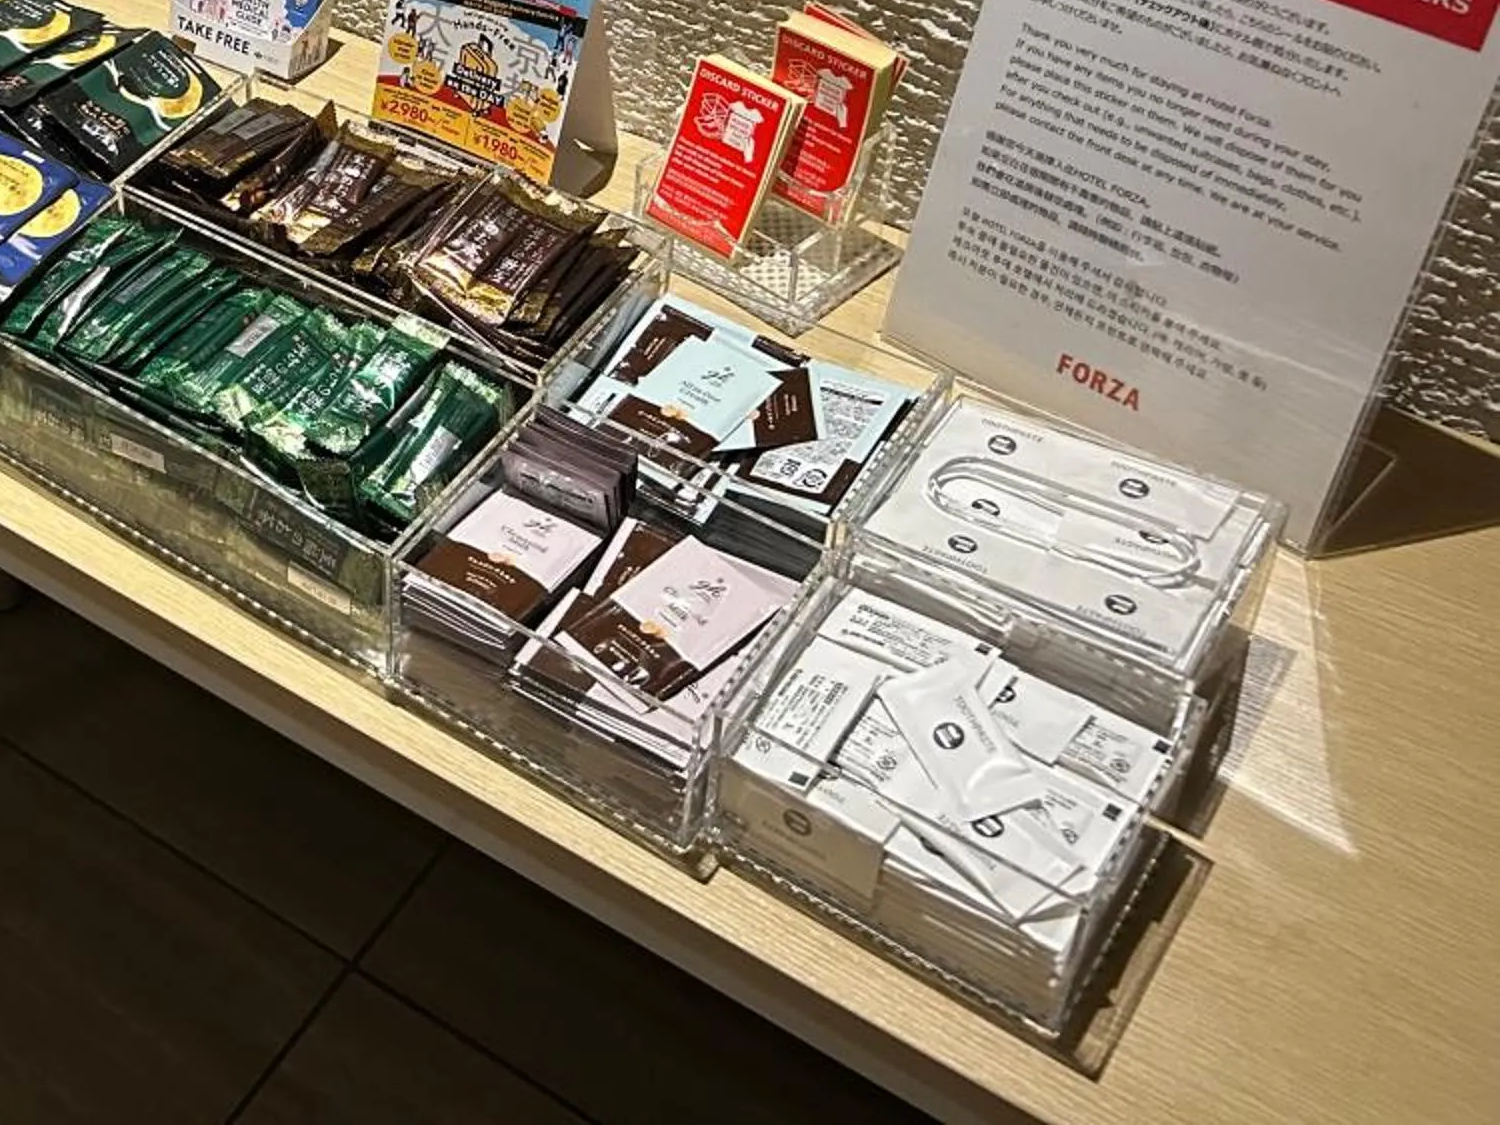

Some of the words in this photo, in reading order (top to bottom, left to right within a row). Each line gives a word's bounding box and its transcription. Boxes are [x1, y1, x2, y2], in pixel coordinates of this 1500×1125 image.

[177, 15, 213, 40] TAKE
[216, 33, 251, 54] FREE
[453, 18, 517, 50] Hands-Free
[782, 35, 826, 60] DISCARD
[828, 53, 867, 78] STICKER
[456, 62, 498, 87] Delivery
[481, 89, 504, 105] DAY
[700, 68, 741, 93] DISCARD
[741, 85, 780, 112] STICKER
[1015, 38, 1025, 49] If
[1027, 45, 1045, 58] you
[1047, 50, 1073, 69] have
[1073, 63, 1093, 78] any
[1095, 71, 1125, 90] items
[1126, 84, 1147, 99] you
[1148, 93, 1164, 105] no
[1165, 98, 1202, 119] longer
[1202, 114, 1233, 133] need
[1233, 126, 1272, 148] during
[1273, 143, 1301, 158] your
[1022, 22, 1051, 42] Thank
[1053, 38, 1073, 51] you
[1075, 46, 1098, 61] very
[1099, 56, 1130, 73] much
[1131, 66, 1148, 79] for
[1149, 75, 1190, 98] staying
[1190, 92, 1204, 103] at
[1205, 96, 1237, 115] Hotel
[999, 84, 1017, 98] For
[1018, 94, 1062, 119] anything
[1063, 111, 1085, 128] that
[1087, 122, 1119, 141] needs
[1120, 135, 1133, 148] to
[1133, 140, 1149, 154] be
[1150, 148, 1199, 174] disposed
[1199, 169, 1214, 179] of
[1005, 71, 1029, 86] after
[1030, 82, 1050, 95] you
[1051, 90, 1080, 107] check
[1082, 102, 1101, 116] out
[1134, 124, 1188, 152] unwanted
[1009, 56, 1043, 74] please
[1043, 69, 1071, 86] place
[1073, 80, 1093, 94] this
[1094, 90, 1128, 108] sticker
[1130, 104, 1146, 116] on
[1183, 123, 1201, 138] We
[1203, 134, 1224, 147] will
[1224, 142, 1269, 165] dispose
[1270, 160, 1284, 170] of
[1285, 165, 1317, 184] them
[1318, 178, 1336, 191] for
[1339, 188, 1363, 203] you
[995, 102, 1027, 120] please
[1027, 116, 1065, 136] contact
[1067, 130, 1085, 145] the
[1086, 138, 1112, 156] front
[1113, 151, 1140, 167] desk
[1140, 163, 1153, 174] at
[1154, 169, 1176, 183] any
[1209, 191, 1229, 205] We
[1230, 200, 1250, 214] are
[1251, 209, 1265, 220] at
[1267, 216, 1294, 231] your
[1056, 353, 1139, 412] FORZA
[951, 691, 998, 756] TOOTHPASTE
